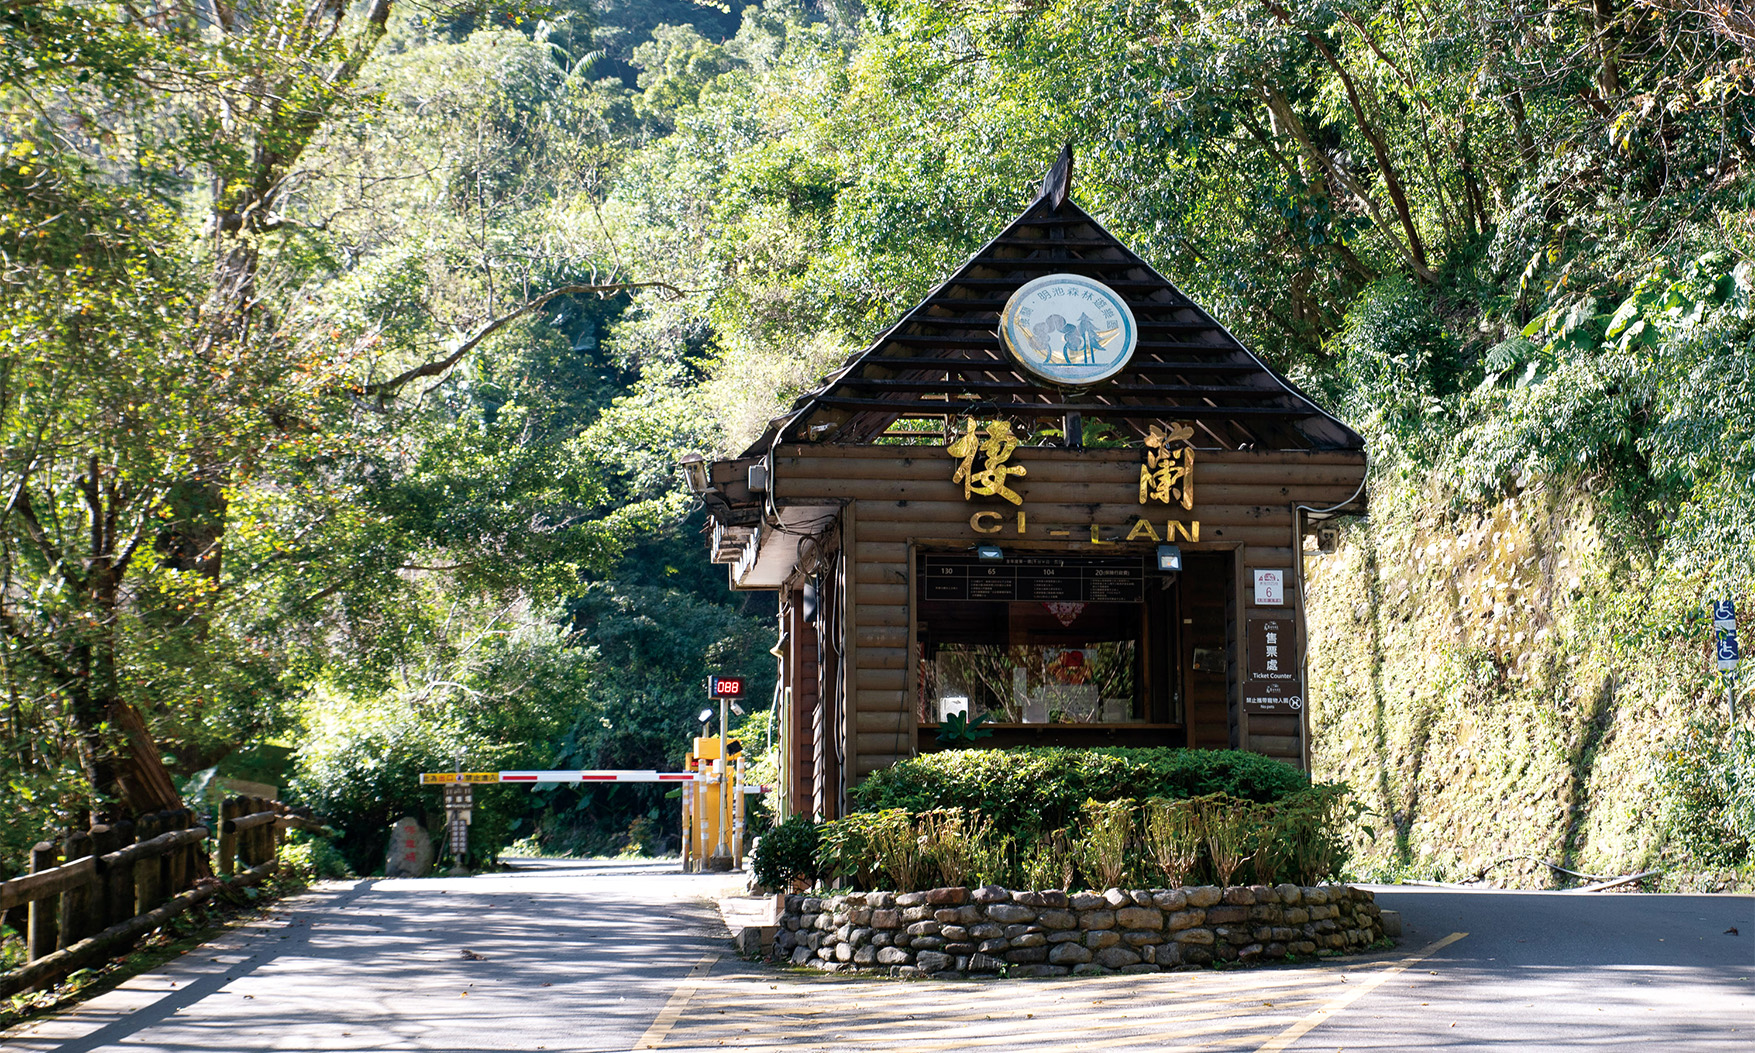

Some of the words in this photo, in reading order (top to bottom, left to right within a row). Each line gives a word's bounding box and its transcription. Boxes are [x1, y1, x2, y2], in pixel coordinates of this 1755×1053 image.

[940, 567, 953, 575] 130
[987, 568, 996, 576] 65
[1266, 586, 1272, 598] 6
[1266, 632, 1278, 671] 售票處
[718, 681, 739, 693] 088
